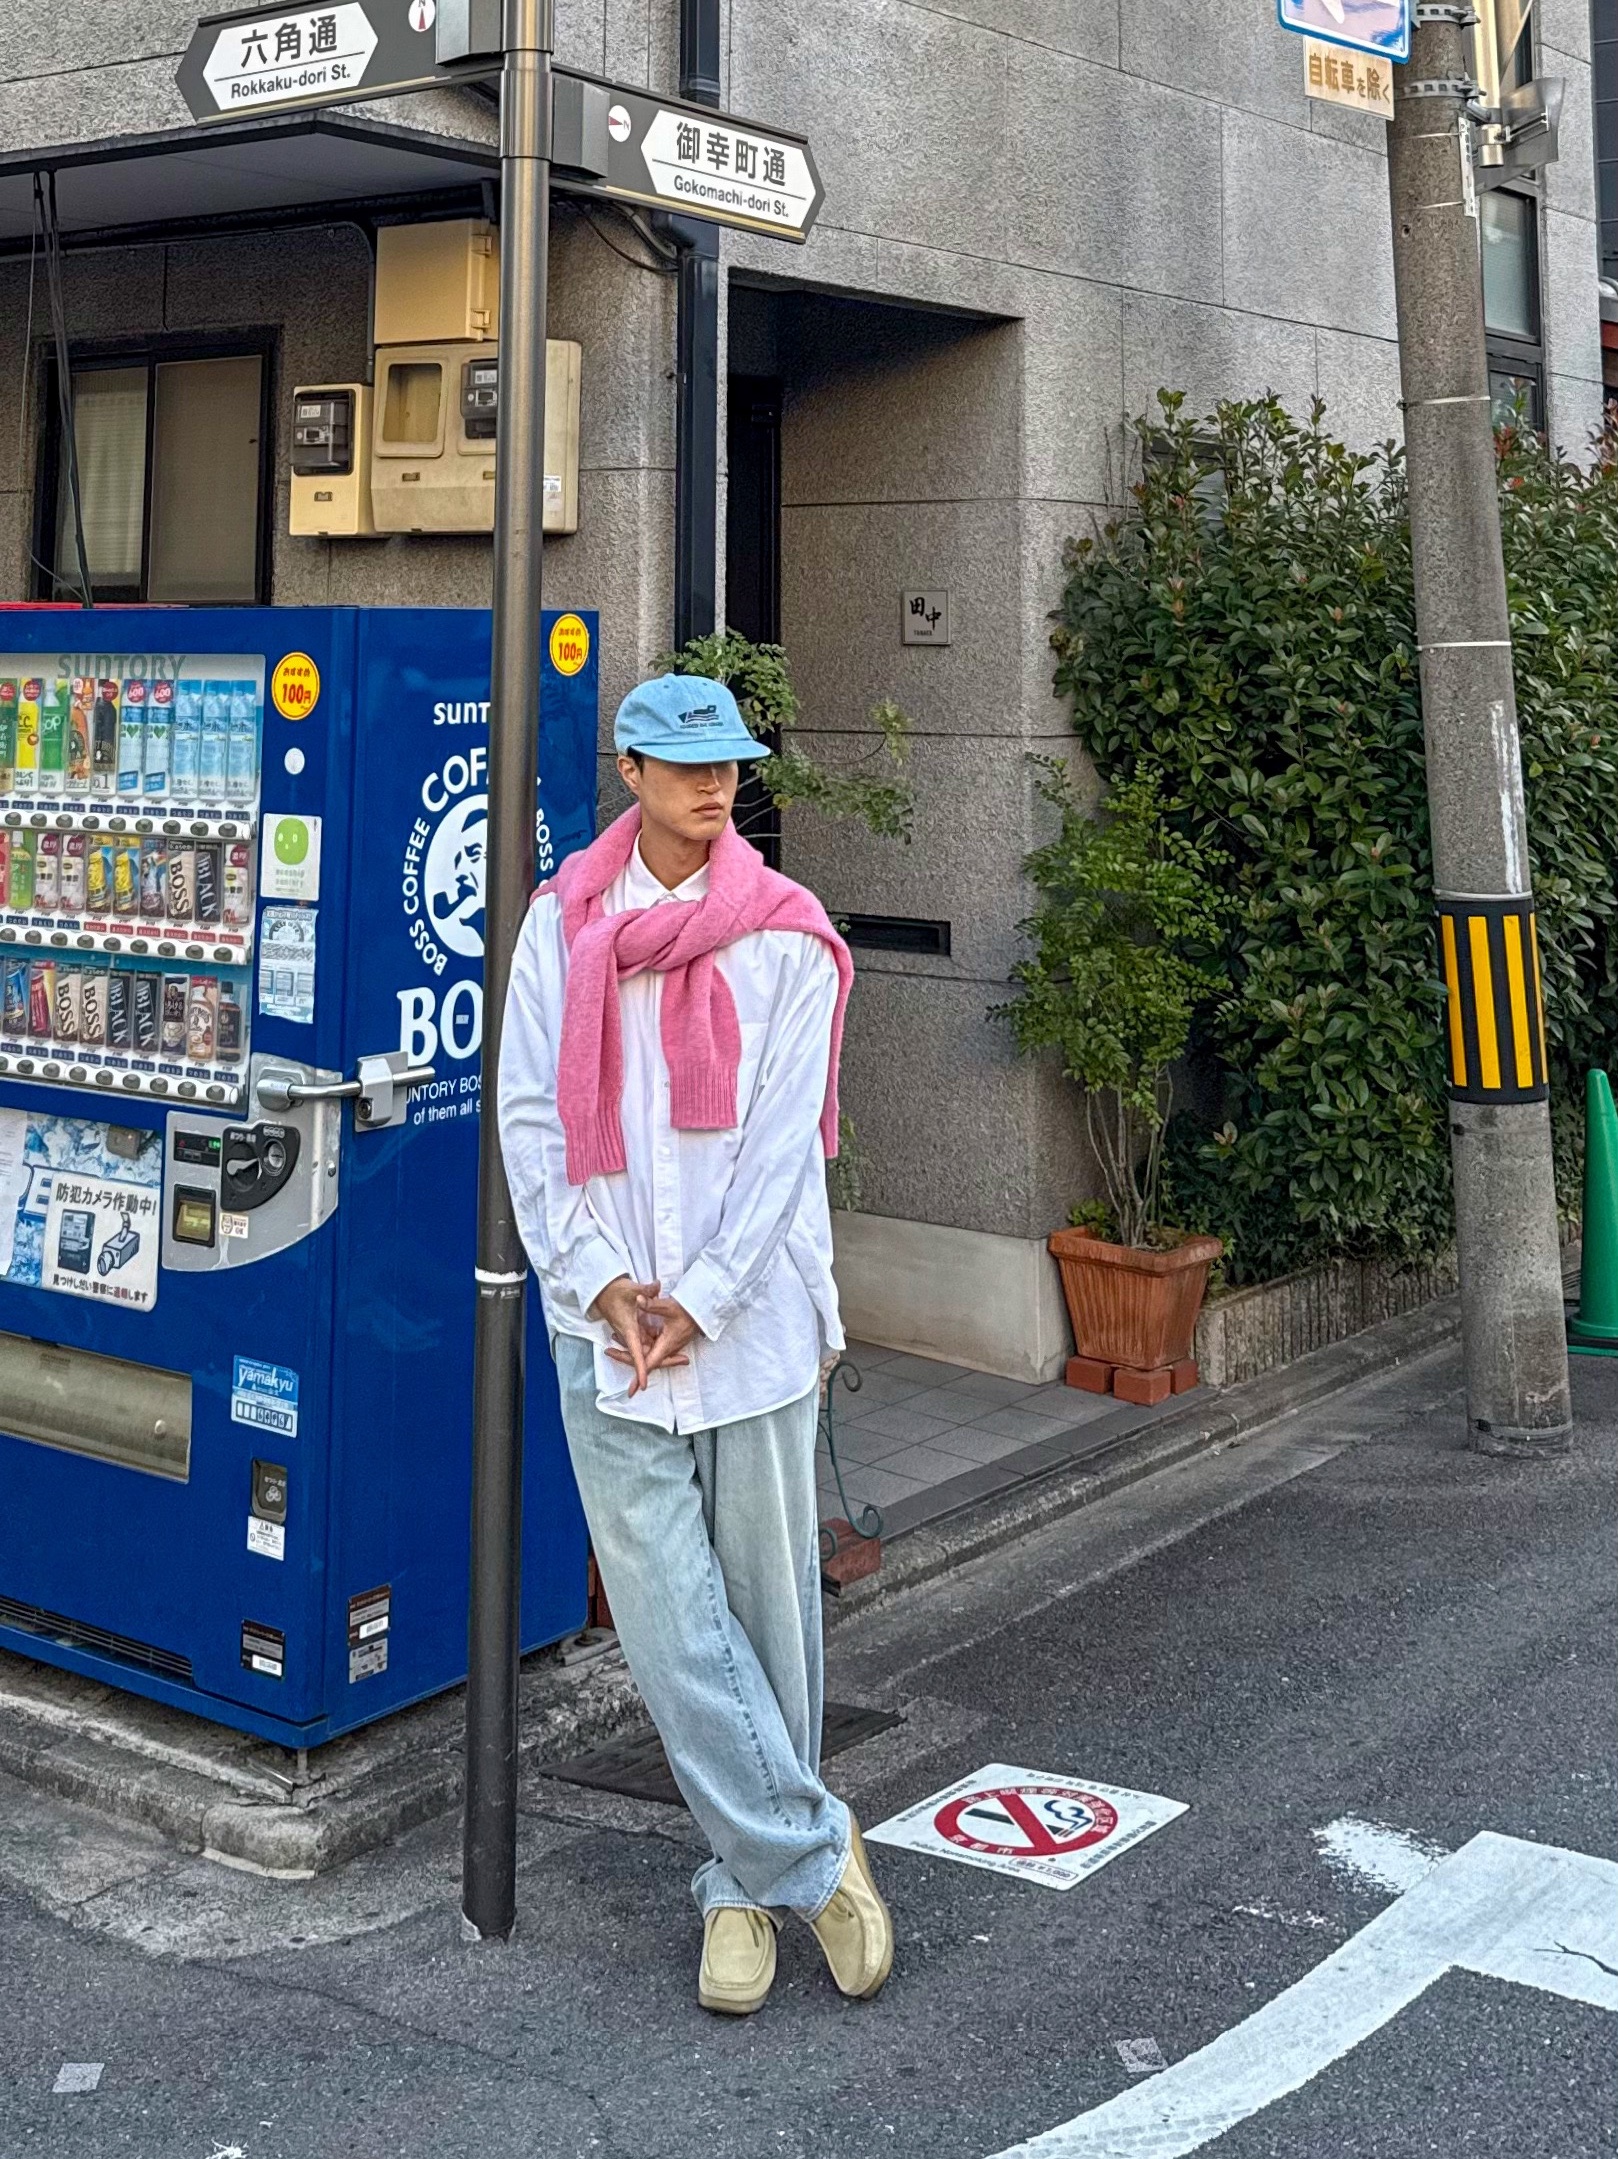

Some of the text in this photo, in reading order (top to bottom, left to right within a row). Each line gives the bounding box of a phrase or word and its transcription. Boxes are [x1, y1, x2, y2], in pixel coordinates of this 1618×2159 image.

[240, 14, 337, 68] 六角通
[231, 63, 351, 99] Rokkaku-dori St.
[1309, 52, 1391, 104] 自転車を除く
[676, 121, 786, 187] 御幸町通
[674, 175, 789, 217] Gokomachi-dori St.
[909, 596, 942, 631] 田中
[58, 654, 186, 680] SUNTORY
[283, 667, 311, 677] おすすめ
[559, 642, 582, 661] 100円
[282, 683, 311, 704] 100円
[422, 747, 489, 812] COF
[170, 861, 189, 912] BOSS
[198, 856, 217, 917] BLACK
[402, 817, 448, 976] BOSS COFFEE
[58, 983, 75, 1033] BOSS
[84, 985, 101, 1036] BOSS
[110, 981, 128, 1043] BLACK
[137, 983, 155, 1046] BLACK
[414, 1108, 425, 1125] of
[428, 1104, 457, 1120] them
[460, 1098, 472, 1115] all
[55, 1182, 157, 1216] 防犯カメラ作動中!
[238, 1366, 293, 1393] yamakyu
[910, 1841, 938, 1852] Public
[997, 1863, 1020, 1873] Area
